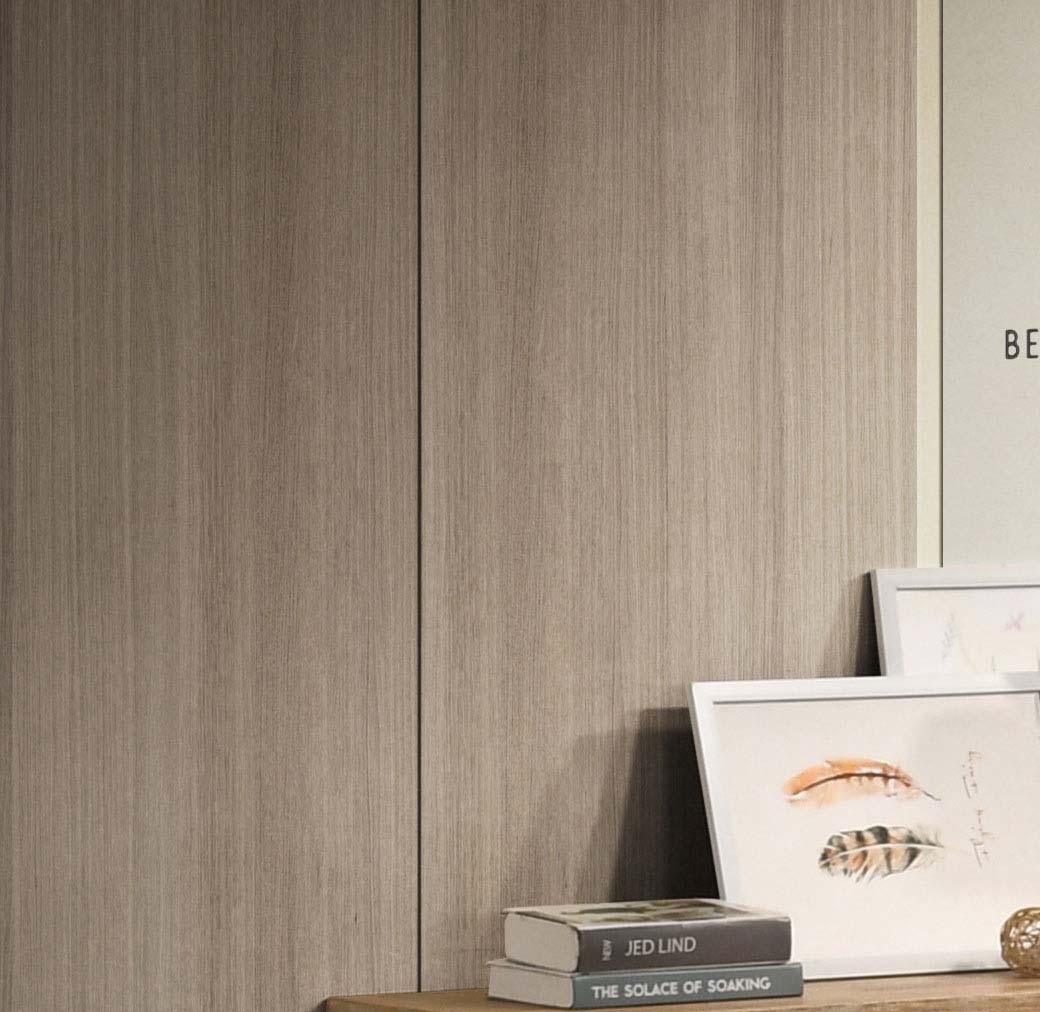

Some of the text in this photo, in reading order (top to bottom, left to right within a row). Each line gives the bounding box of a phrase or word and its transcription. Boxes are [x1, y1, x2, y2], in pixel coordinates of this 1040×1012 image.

[1004, 328, 1040, 360] BE
[625, 936, 697, 957] JED LIND
[591, 976, 771, 999] THE SOLACE OF SOAKING
